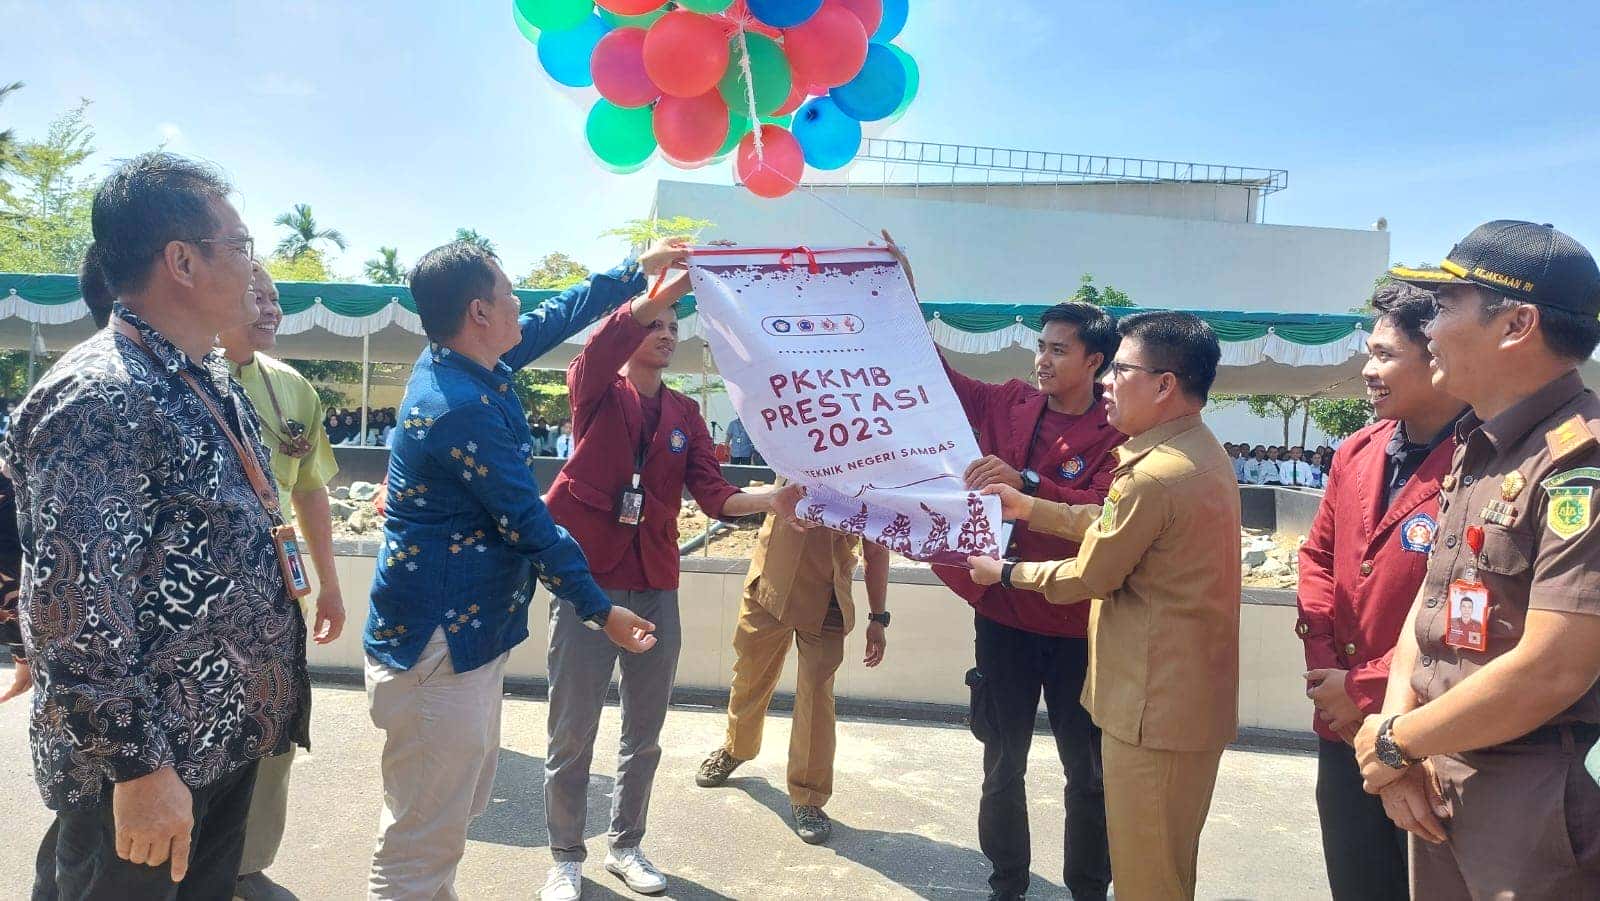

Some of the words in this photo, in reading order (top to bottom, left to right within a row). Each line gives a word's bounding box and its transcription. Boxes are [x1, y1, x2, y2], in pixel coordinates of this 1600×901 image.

[769, 366, 892, 399] PKKMB
[760, 384, 930, 431] PRESTASI
[807, 416, 893, 453] 2023
[847, 451, 895, 470] NEGERI
[900, 440, 955, 458] SAMBAS
